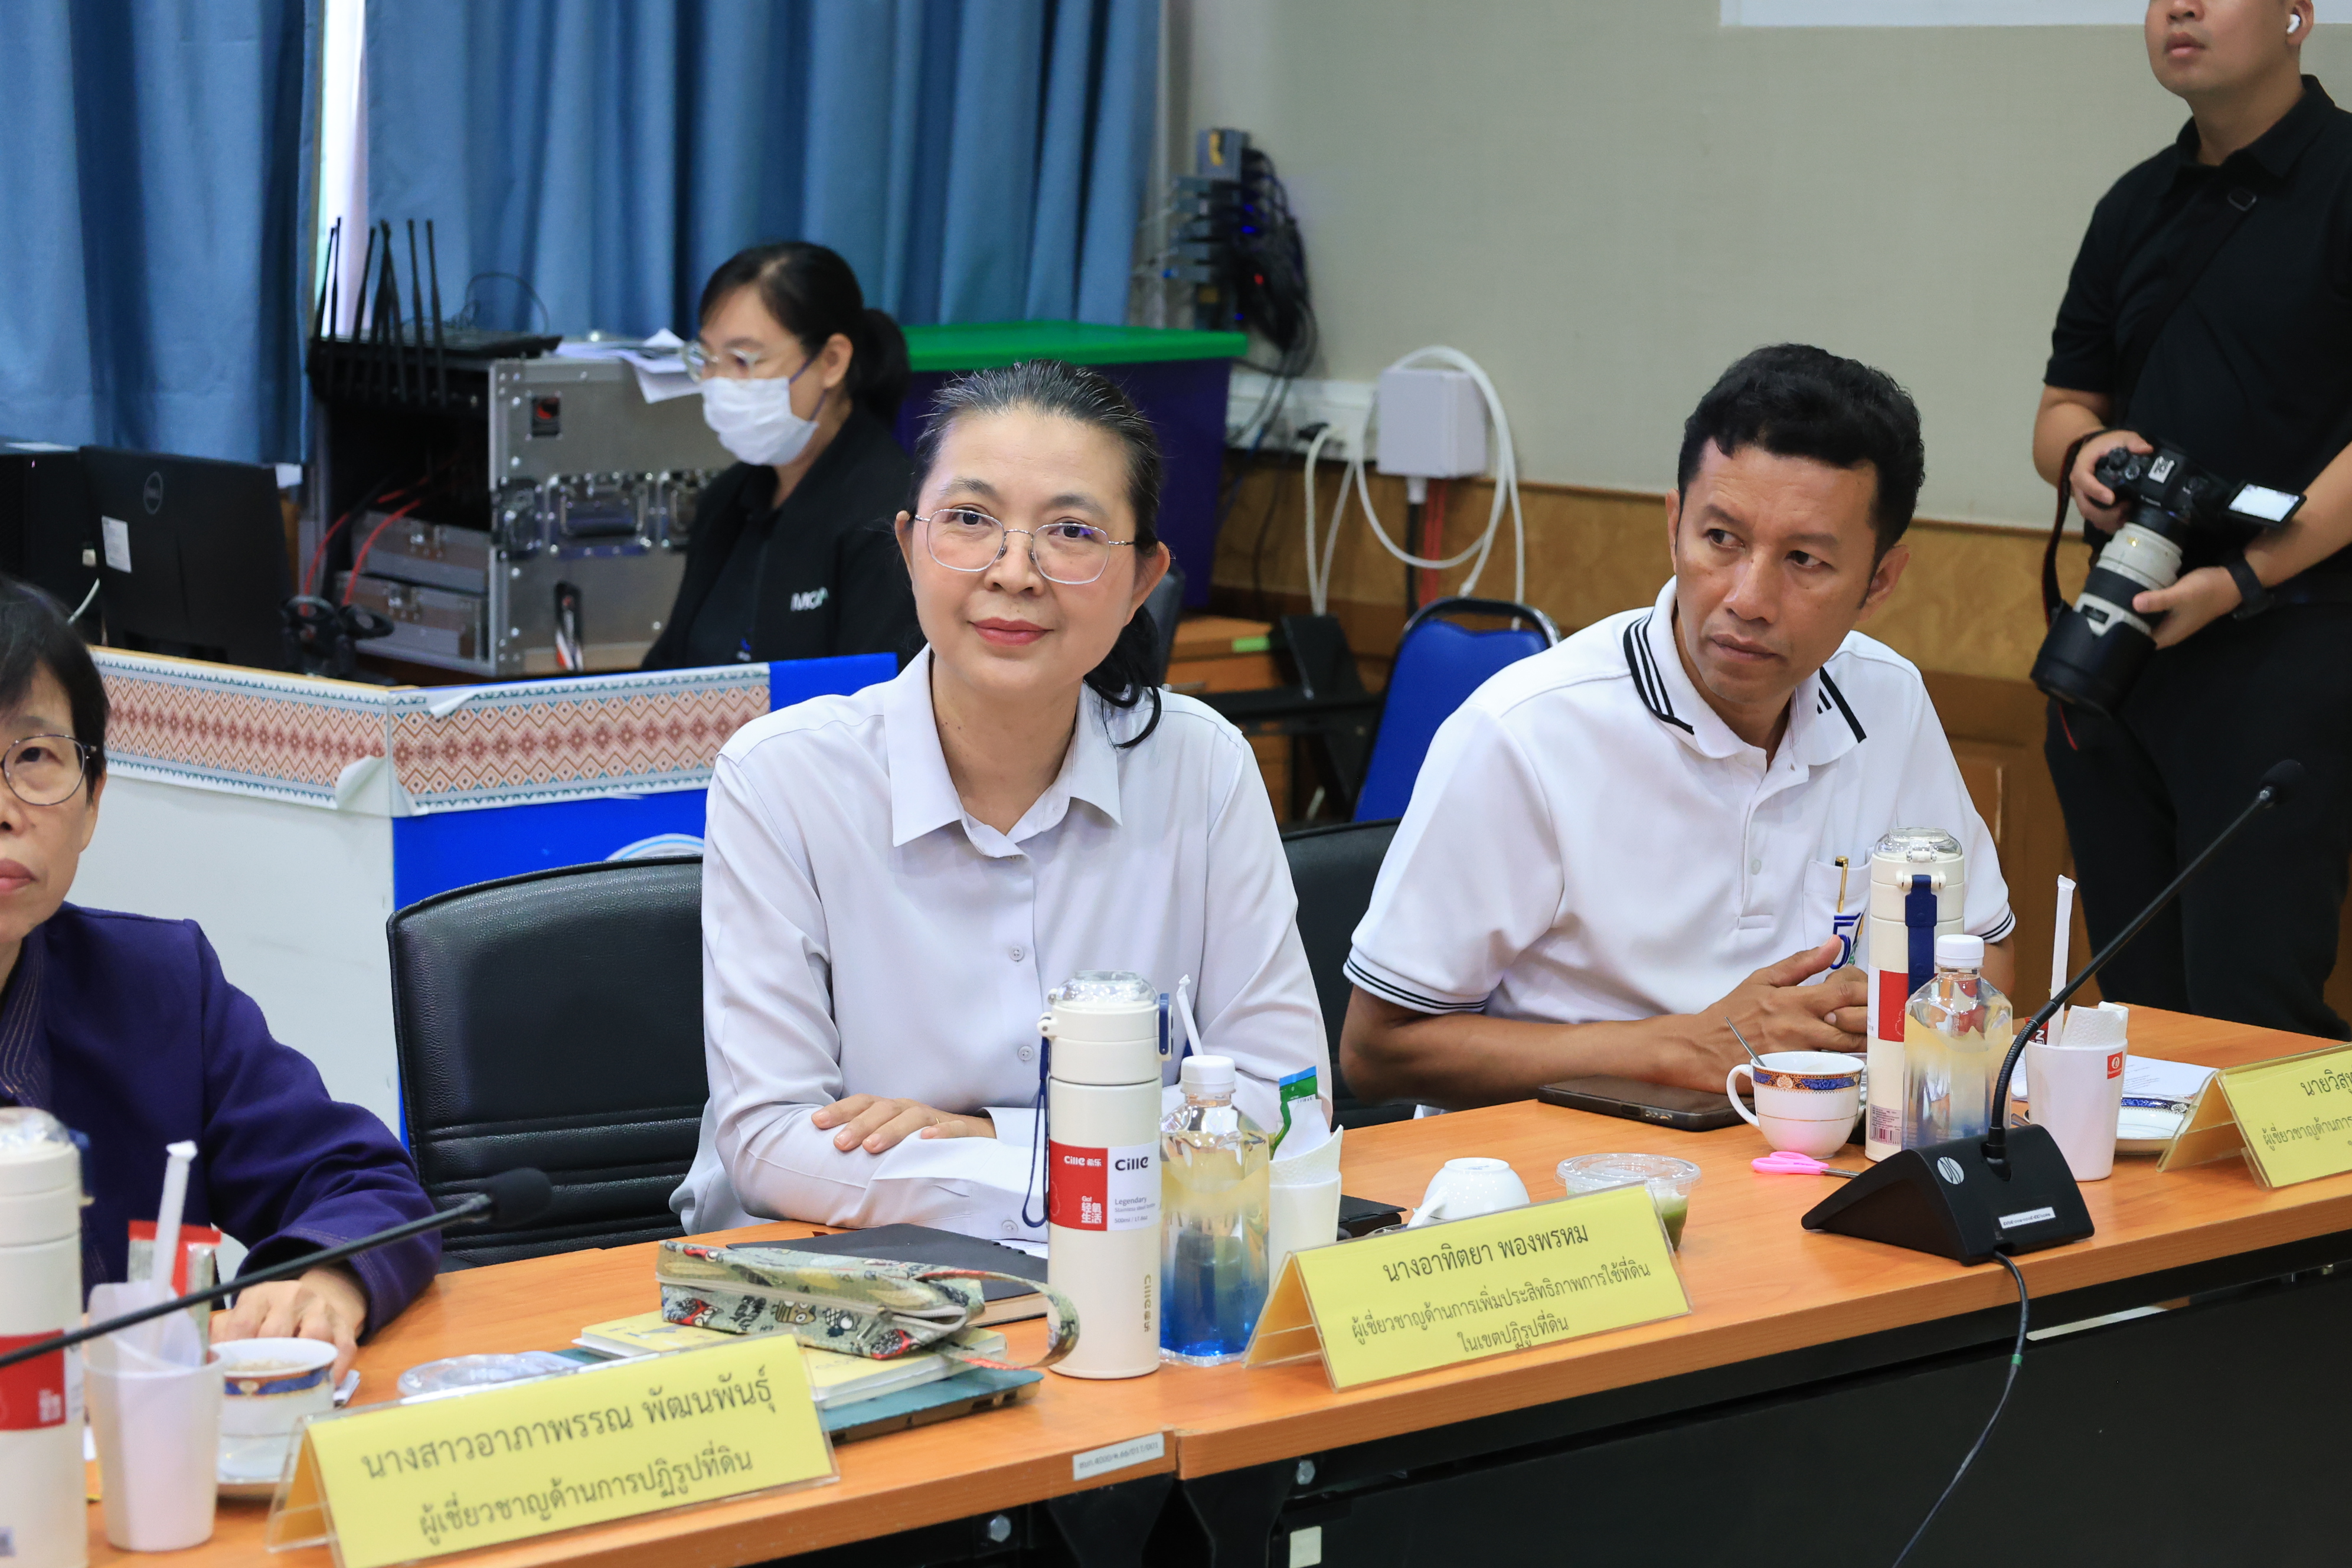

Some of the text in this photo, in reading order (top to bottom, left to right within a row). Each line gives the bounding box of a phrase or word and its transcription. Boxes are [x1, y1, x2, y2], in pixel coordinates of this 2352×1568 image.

[1115, 1196, 1147, 1206] Legendary
[1382, 1224, 1589, 1282] นางอาทิตยา พองพรหม
[1351, 1256, 1651, 1345] ผู้เชี่ยวชาญด้านการเพิ่มประสิทธิภาพการใช้ที่ดิน
[1456, 1309, 1569, 1352] ในเขตปฏิรูปที่ดิน
[361, 1364, 777, 1479] นางสาวอาภาพรรณ พัฒนพันธุ์
[420, 1440, 753, 1546] ผู้เชี่ยวชาญด้านการปฏิรูปที่ดิน
